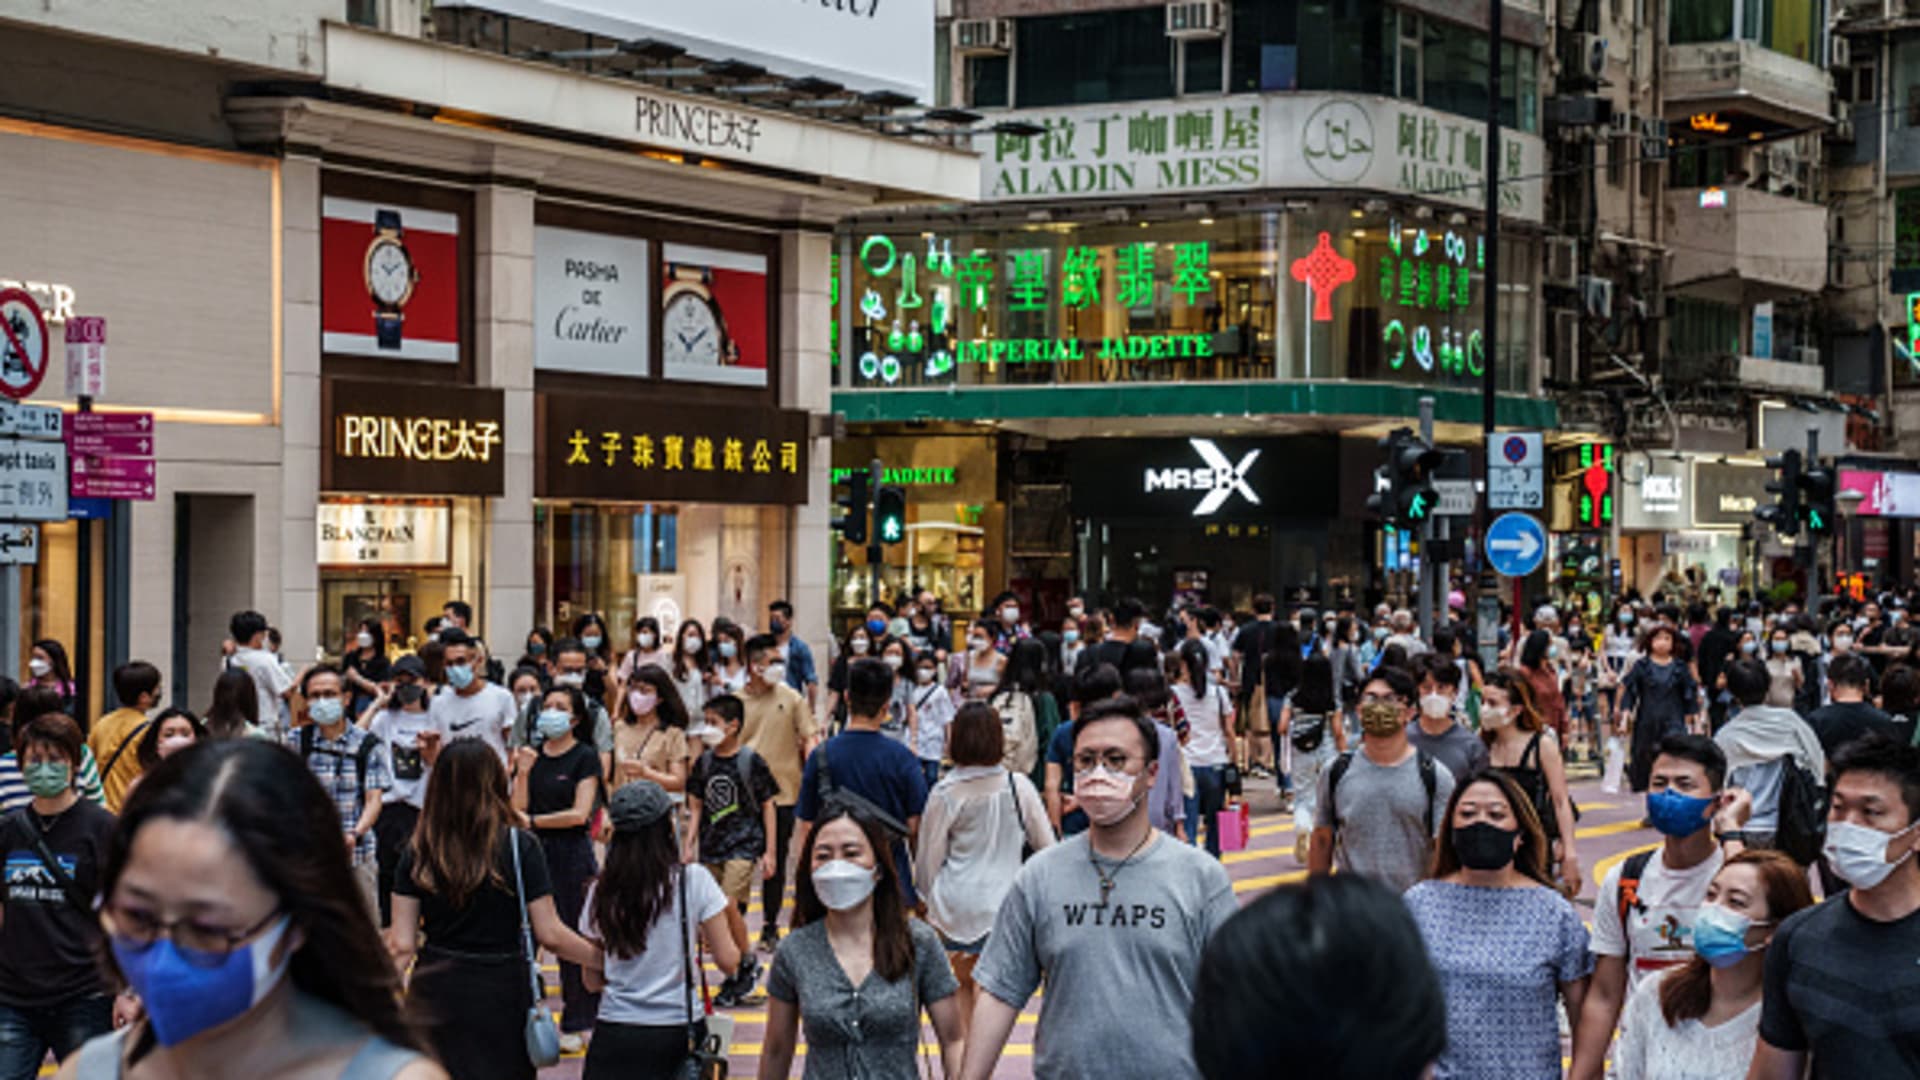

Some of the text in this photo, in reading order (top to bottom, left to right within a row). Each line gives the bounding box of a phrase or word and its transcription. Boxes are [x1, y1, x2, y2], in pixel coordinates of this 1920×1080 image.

[1398, 112, 1522, 178] 阿拉丁咖屋
[993, 154, 1261, 196] ALADIN MESS
[565, 259, 619, 283] PASHA
[582, 290, 601, 306] DE
[555, 306, 626, 343] Cartier
[956, 333, 1214, 363] IMPERIAL JADEITE
[44, 412, 59, 431] 12
[344, 415, 501, 463] PRINCE太子
[25, 452, 56, 471] taxis
[880, 467, 956, 485] JADEITE
[322, 524, 415, 543] BLANCPAIN
[1063, 903, 1166, 929] WTAPS
